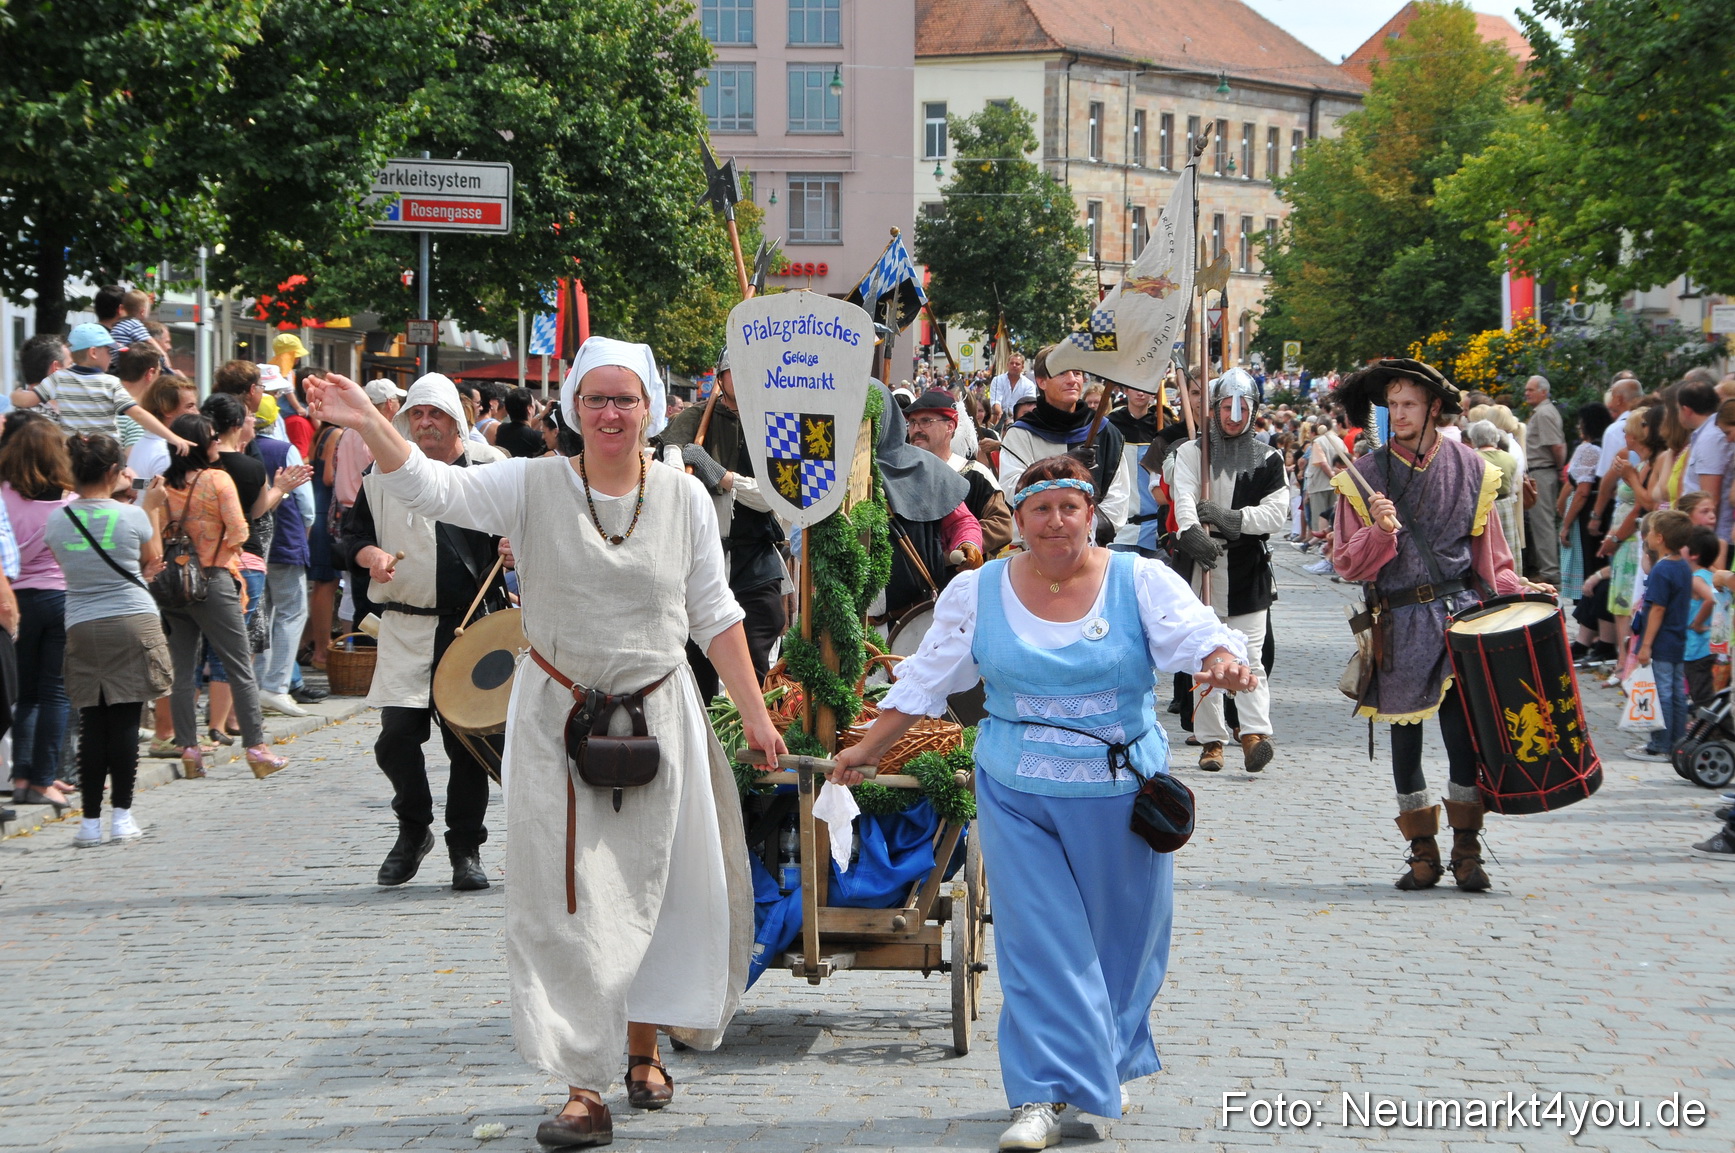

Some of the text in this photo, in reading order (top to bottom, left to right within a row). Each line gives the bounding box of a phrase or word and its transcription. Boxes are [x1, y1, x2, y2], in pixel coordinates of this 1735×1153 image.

[410, 202, 482, 222] Rosengasse
[766, 262, 828, 277] asse
[742, 313, 860, 347] Pfalzgräfisches
[782, 350, 819, 367] Gefolge
[764, 365, 836, 390] Neumarkt
[1637, 698, 1650, 711] M
